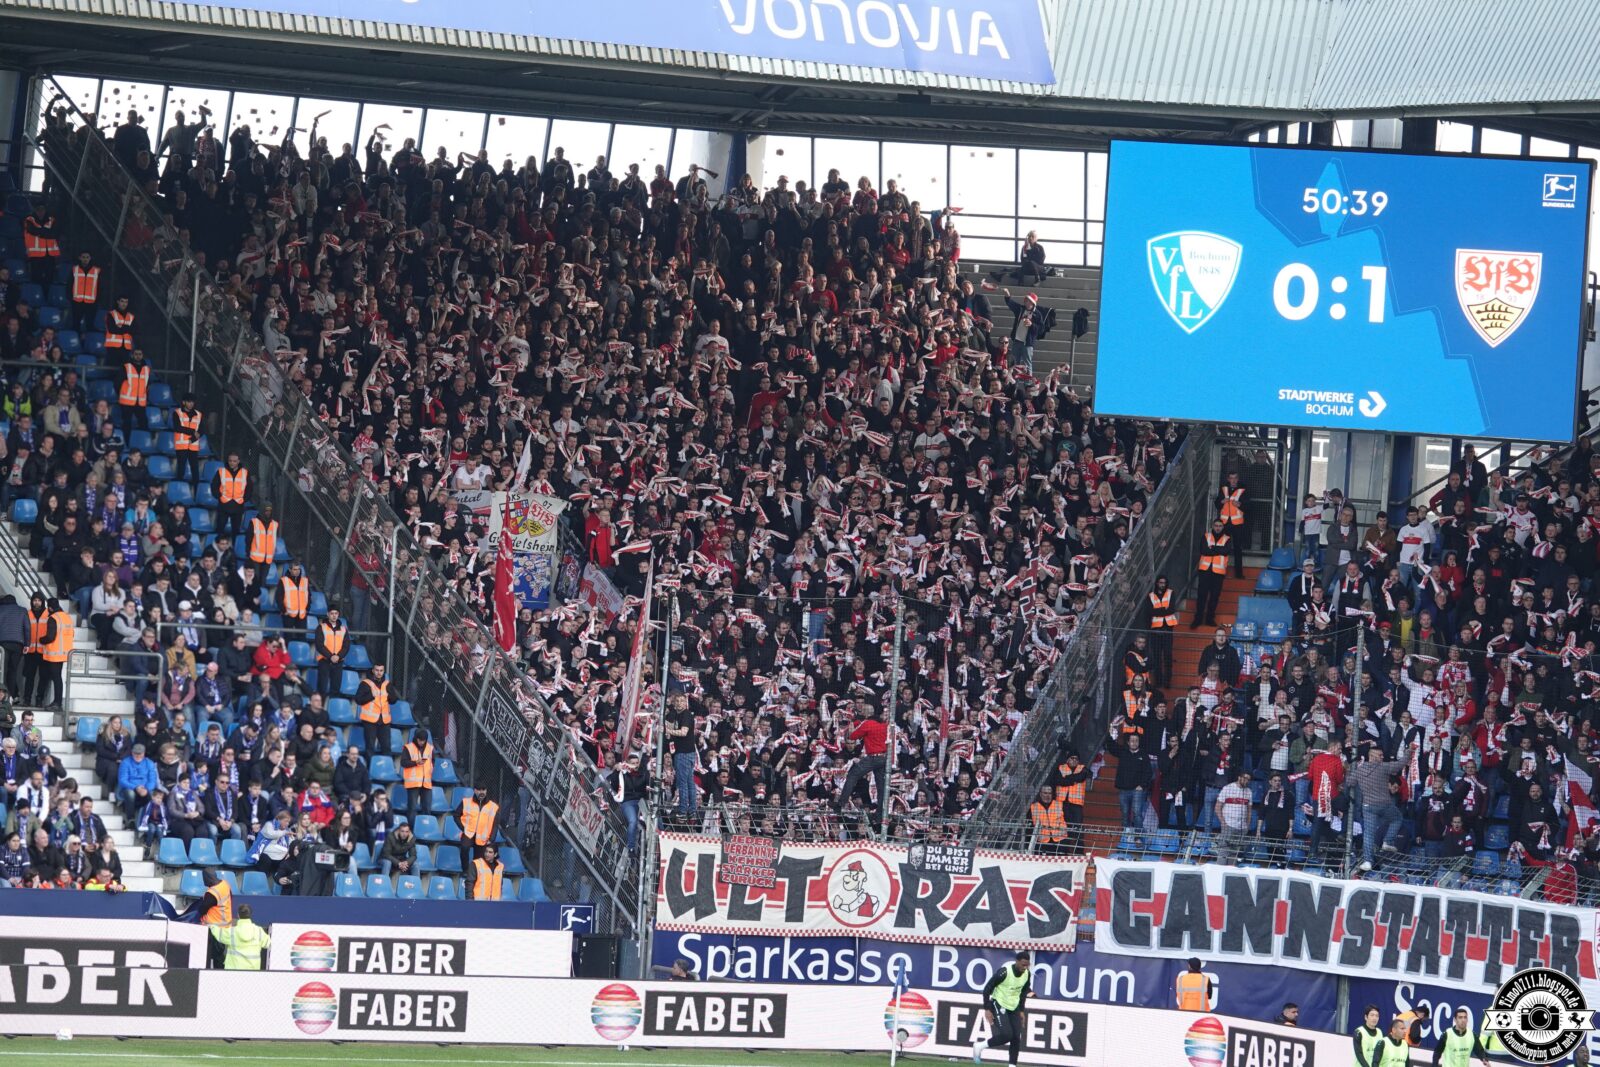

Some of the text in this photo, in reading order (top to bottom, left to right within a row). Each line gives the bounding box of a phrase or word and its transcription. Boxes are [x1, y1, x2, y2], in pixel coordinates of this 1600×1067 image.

[1303, 188, 1388, 216] 50:39
[1463, 256, 1535, 295] VfB
[1273, 262, 1388, 324] 0:1
[1279, 388, 1354, 403] STADTWERKE
[1306, 403, 1354, 416] BOCHUM
[724, 842, 778, 860] VERBANNTE
[731, 834, 774, 847] JEDER
[926, 845, 970, 858] DU BIST
[925, 854, 969, 867] IMMER
[925, 863, 942, 871] BEI
[1111, 867, 1581, 986] CANNSTATTER
[348, 941, 455, 975] FABER
[677, 932, 1136, 1004] Sparkasse Bohum
[349, 993, 456, 1028] FABER
[656, 995, 774, 1033] FABER
[948, 1006, 1074, 1051] FAER
